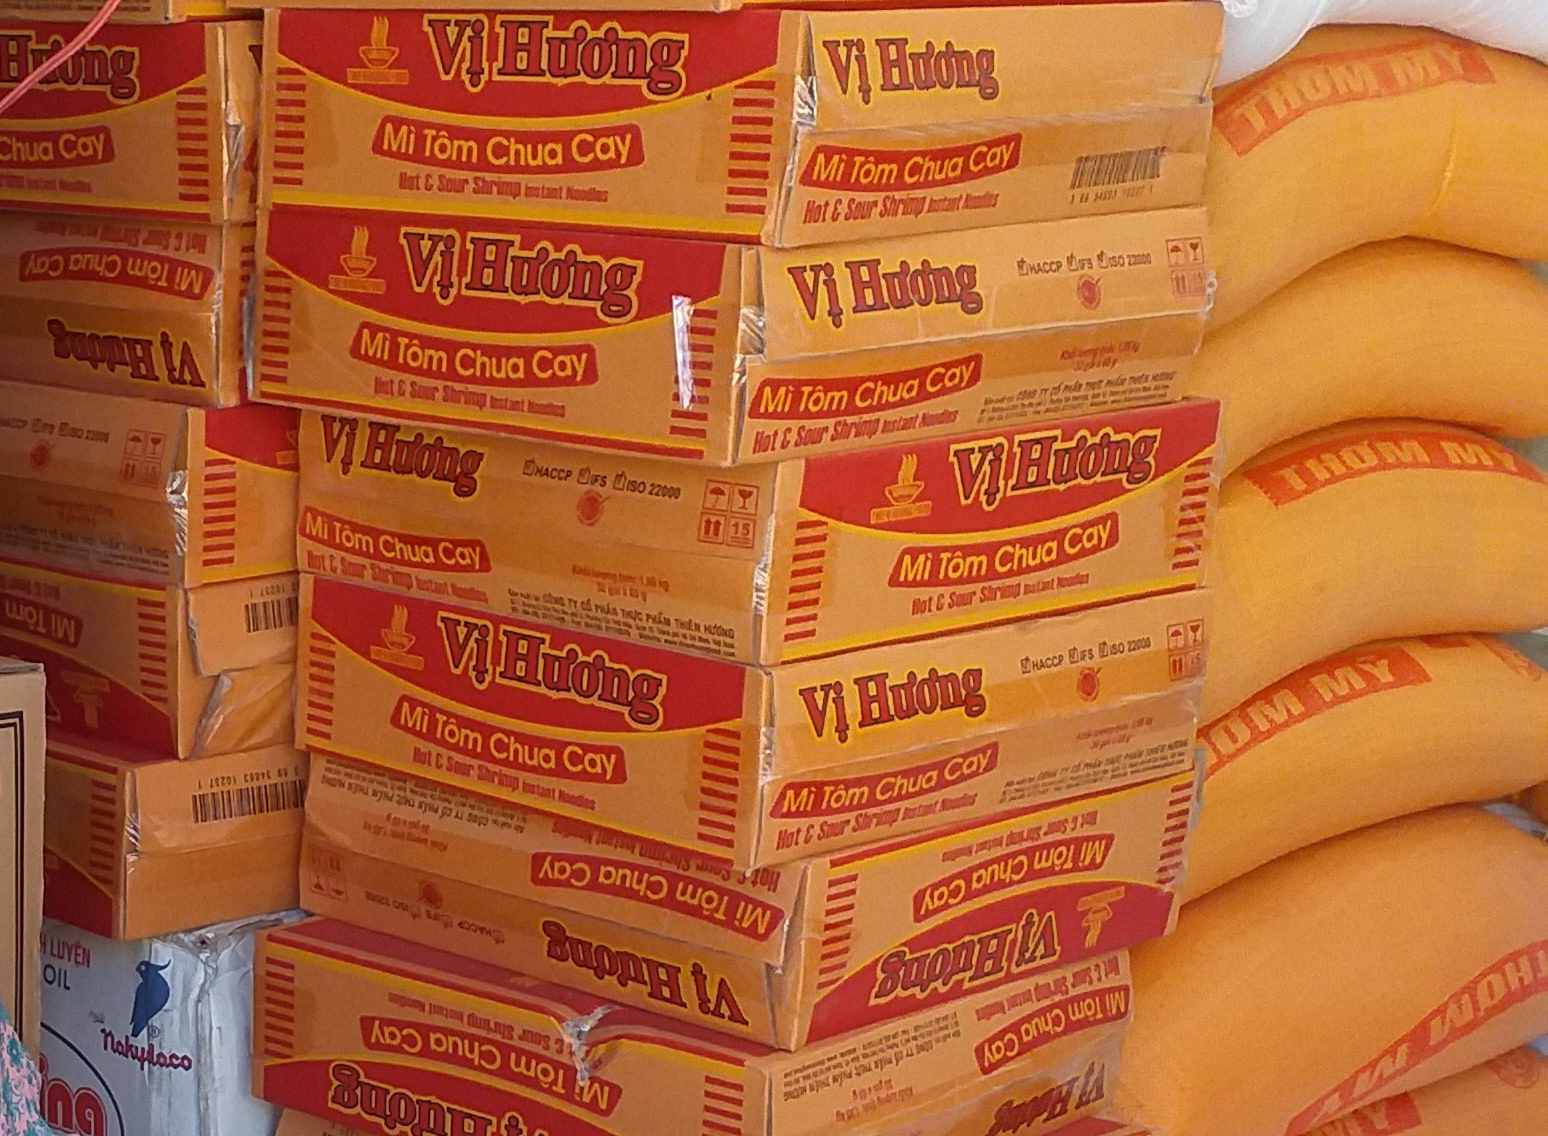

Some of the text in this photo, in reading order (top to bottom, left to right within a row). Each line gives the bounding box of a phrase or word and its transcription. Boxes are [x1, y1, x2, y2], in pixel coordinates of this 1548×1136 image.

[428, 19, 684, 96] Vị Hương
[823, 38, 1000, 105] Vị Hương
[59, 131, 105, 164] Cay
[382, 122, 632, 166] Mì Tôm Chua Cay
[812, 140, 1015, 184] Mì Tôm Chua Cay
[803, 199, 830, 224] Hot
[845, 196, 878, 220] Sour
[25, 254, 168, 286] Tôm Chua Cay
[403, 232, 637, 318] Vị Hương
[1028, 260, 1063, 275] HACCP
[788, 259, 982, 329] Vị Hương
[360, 329, 588, 381] Mì Tôm Chua Cay
[759, 360, 975, 413] Mì Tôm Chua Cay
[321, 414, 485, 498] Vị Hương
[752, 430, 778, 454] Hot
[794, 425, 829, 447] Sour
[534, 466, 646, 494] HACCP IFS ISO
[953, 433, 1158, 507] Vị Hương
[333, 521, 480, 570] Tôm Chua Cay
[732, 521, 751, 537] 15
[899, 519, 1112, 582] Mì Tôm Chua Cay
[440, 615, 490, 685] Vị
[499, 629, 662, 727] Hương
[1032, 654, 1063, 670] HACCP
[1110, 642, 1124, 655] ISO
[799, 668, 986, 744] Vị Hương
[400, 702, 616, 781] Mì Tôm Chua Cay
[782, 786, 816, 813] Mì
[822, 785, 868, 810] Tôm
[876, 769, 937, 801] Chua
[944, 750, 991, 781] Cay
[776, 829, 801, 850] Hot
[817, 819, 850, 841] Sour
[539, 856, 729, 920] Tôm Chua Cay
[920, 845, 1075, 915] Tôm Chua Cay
[43, 964, 70, 991] OIL
[542, 920, 749, 1027] Vị Hương
[876, 910, 1057, 998] Vị Hương
[1021, 1009, 1065, 1040] Chua
[1070, 997, 1102, 1022] Tôm
[370, 1020, 565, 1094] Tôm Chua Cay
[982, 1034, 1019, 1066] Cay
